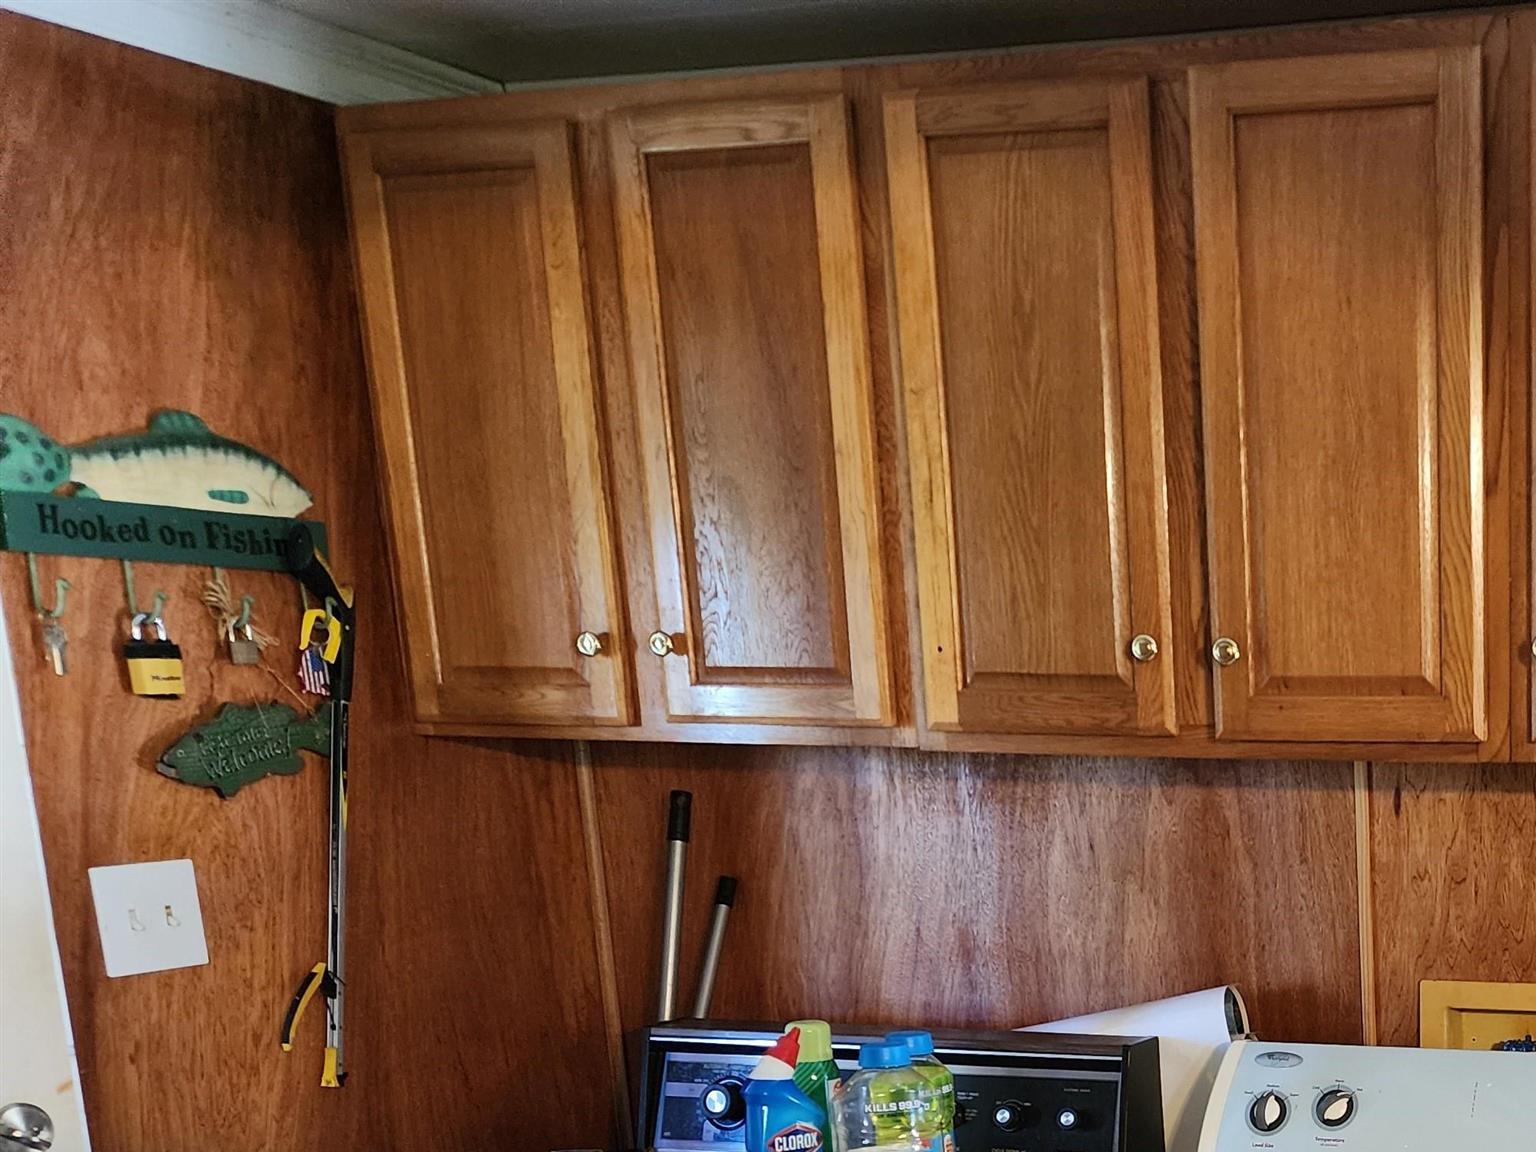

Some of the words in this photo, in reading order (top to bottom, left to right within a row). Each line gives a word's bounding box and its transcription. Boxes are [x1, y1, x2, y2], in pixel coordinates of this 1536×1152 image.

[36, 503, 152, 543] Hooked
[159, 524, 197, 549] on
[203, 520, 290, 557] Fishin
[864, 1103, 898, 1113] KILLS
[774, 1132, 819, 1152] CLOROX
